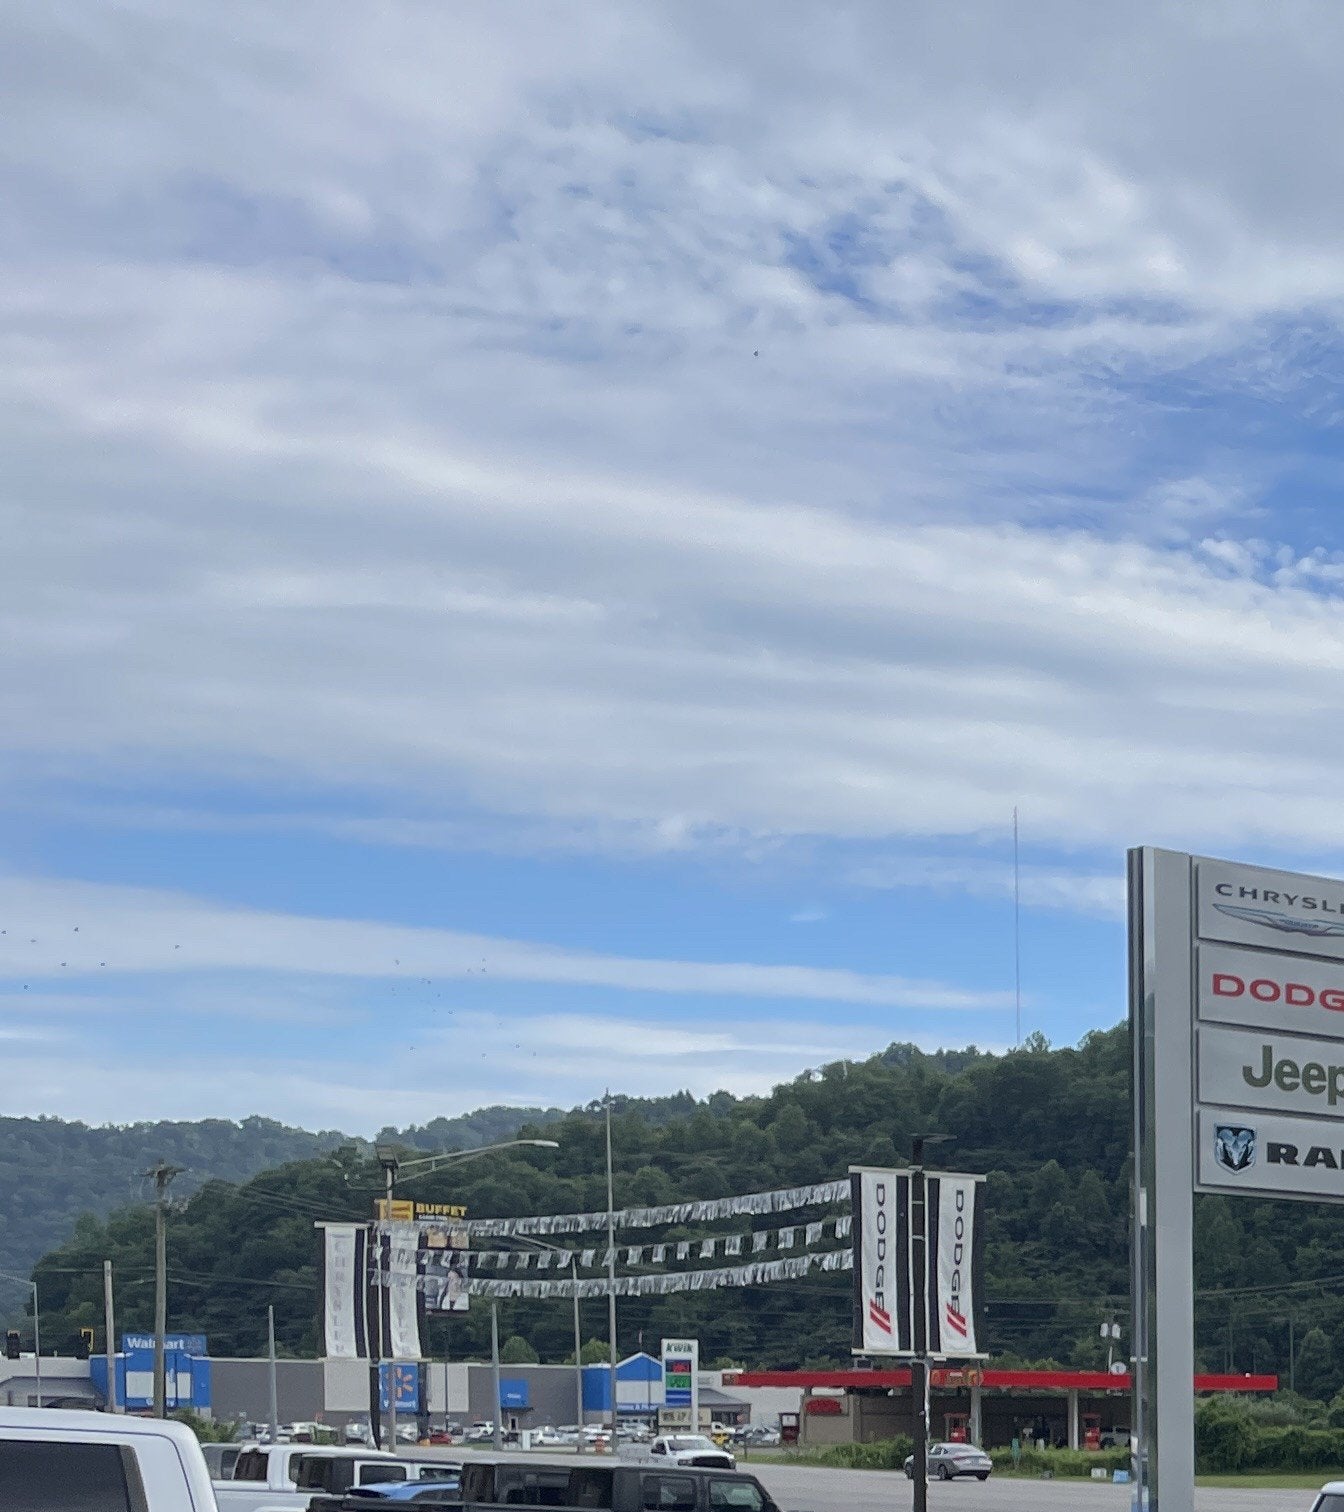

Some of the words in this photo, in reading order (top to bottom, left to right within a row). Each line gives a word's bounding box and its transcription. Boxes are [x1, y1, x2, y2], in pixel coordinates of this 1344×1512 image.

[416, 1203, 467, 1217] BUFFET
[875, 1183, 886, 1311] DODGE
[951, 1189, 964, 1314] DODGE
